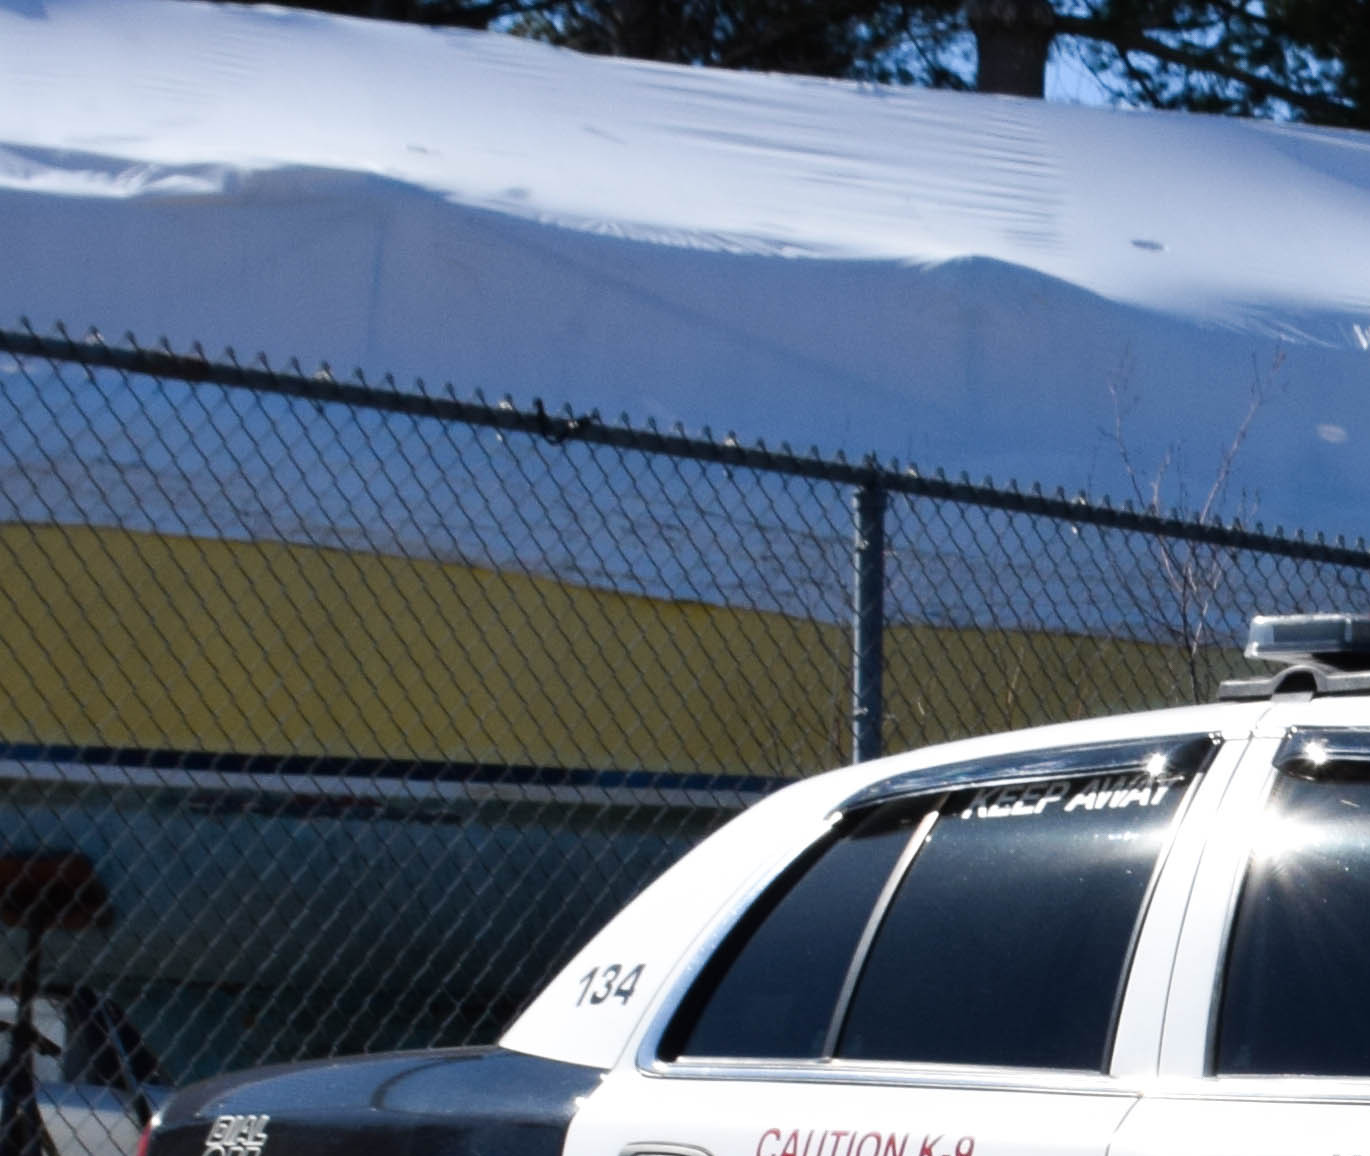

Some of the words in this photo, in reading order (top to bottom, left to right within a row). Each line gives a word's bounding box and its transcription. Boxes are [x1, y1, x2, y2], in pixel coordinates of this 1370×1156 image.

[961, 781, 1070, 819] KEEP
[1064, 776, 1178, 812] AWAY
[576, 963, 647, 1007] 134
[205, 1114, 270, 1147] DIAL
